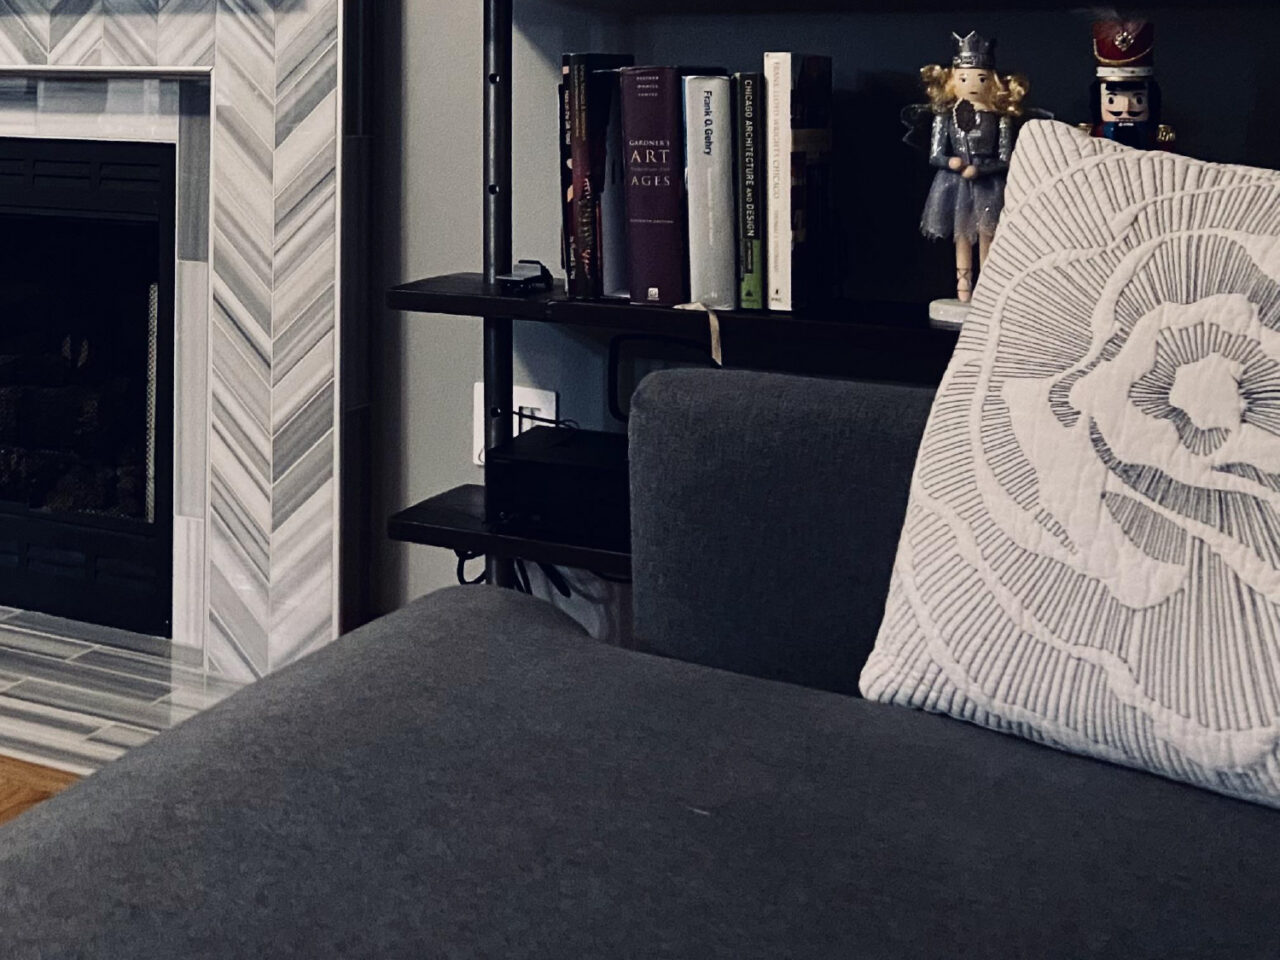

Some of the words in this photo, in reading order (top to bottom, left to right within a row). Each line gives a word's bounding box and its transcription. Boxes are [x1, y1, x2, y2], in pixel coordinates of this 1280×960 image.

[772, 62, 780, 87] FRANK
[703, 90, 713, 117] Frank
[744, 79, 753, 118] CHICAGO
[772, 89, 780, 116] LLOYD
[629, 139, 670, 147] GARDNER'S
[703, 128, 714, 156] Gehry
[744, 120, 754, 186] ARCHITECTURE
[630, 148, 670, 164] ART
[631, 175, 671, 187] AGES
[772, 159, 781, 199] CHICAGO
[746, 203, 755, 237] DESIGN
